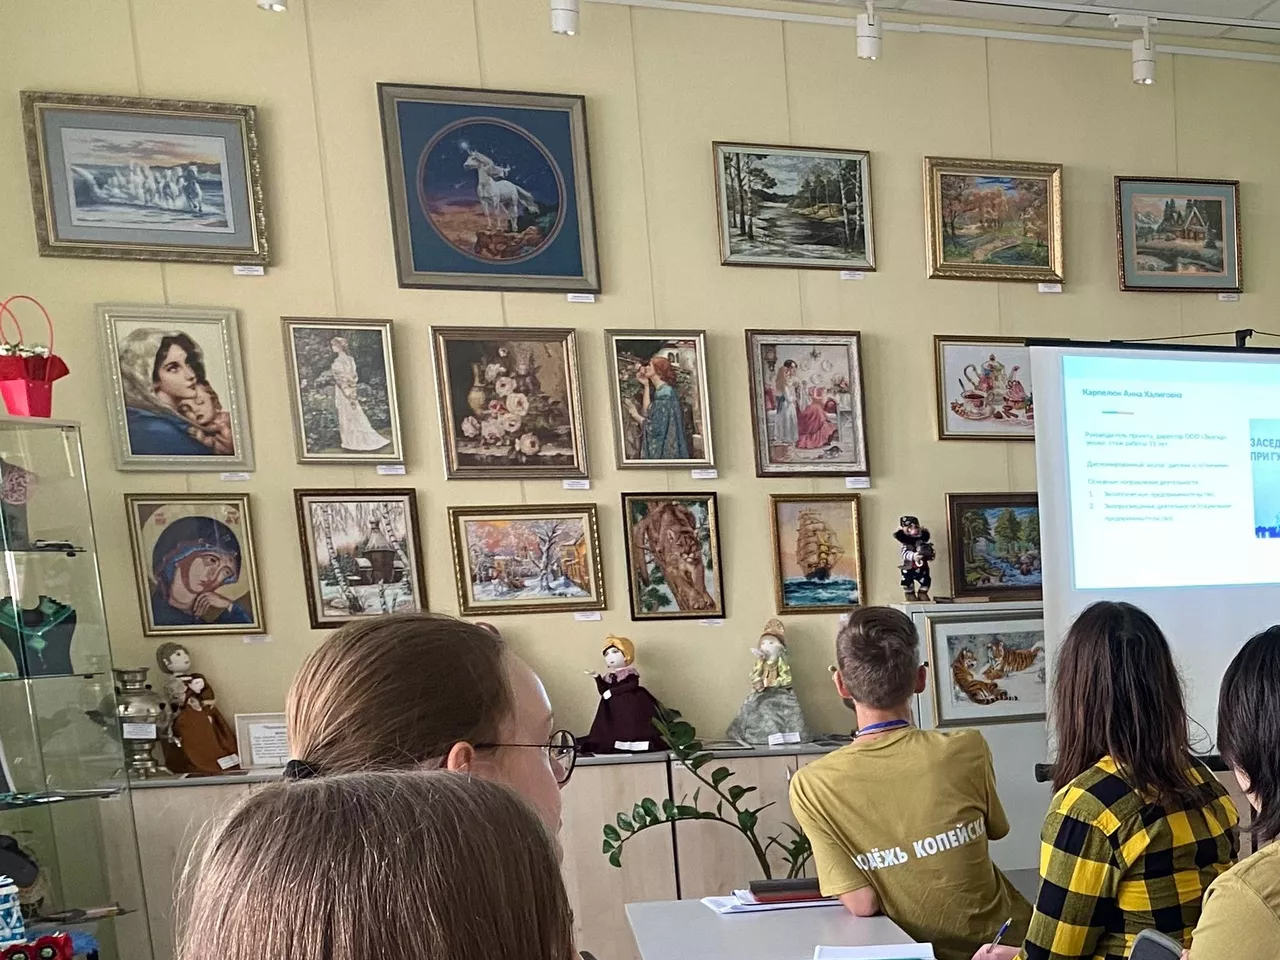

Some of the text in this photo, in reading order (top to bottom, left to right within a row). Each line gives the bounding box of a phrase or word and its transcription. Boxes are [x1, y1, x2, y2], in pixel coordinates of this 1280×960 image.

[1123, 389, 1142, 398] Анна
[1250, 451, 1269, 461] ПРИ
[851, 847, 909, 870] ОДЁЖЬ
